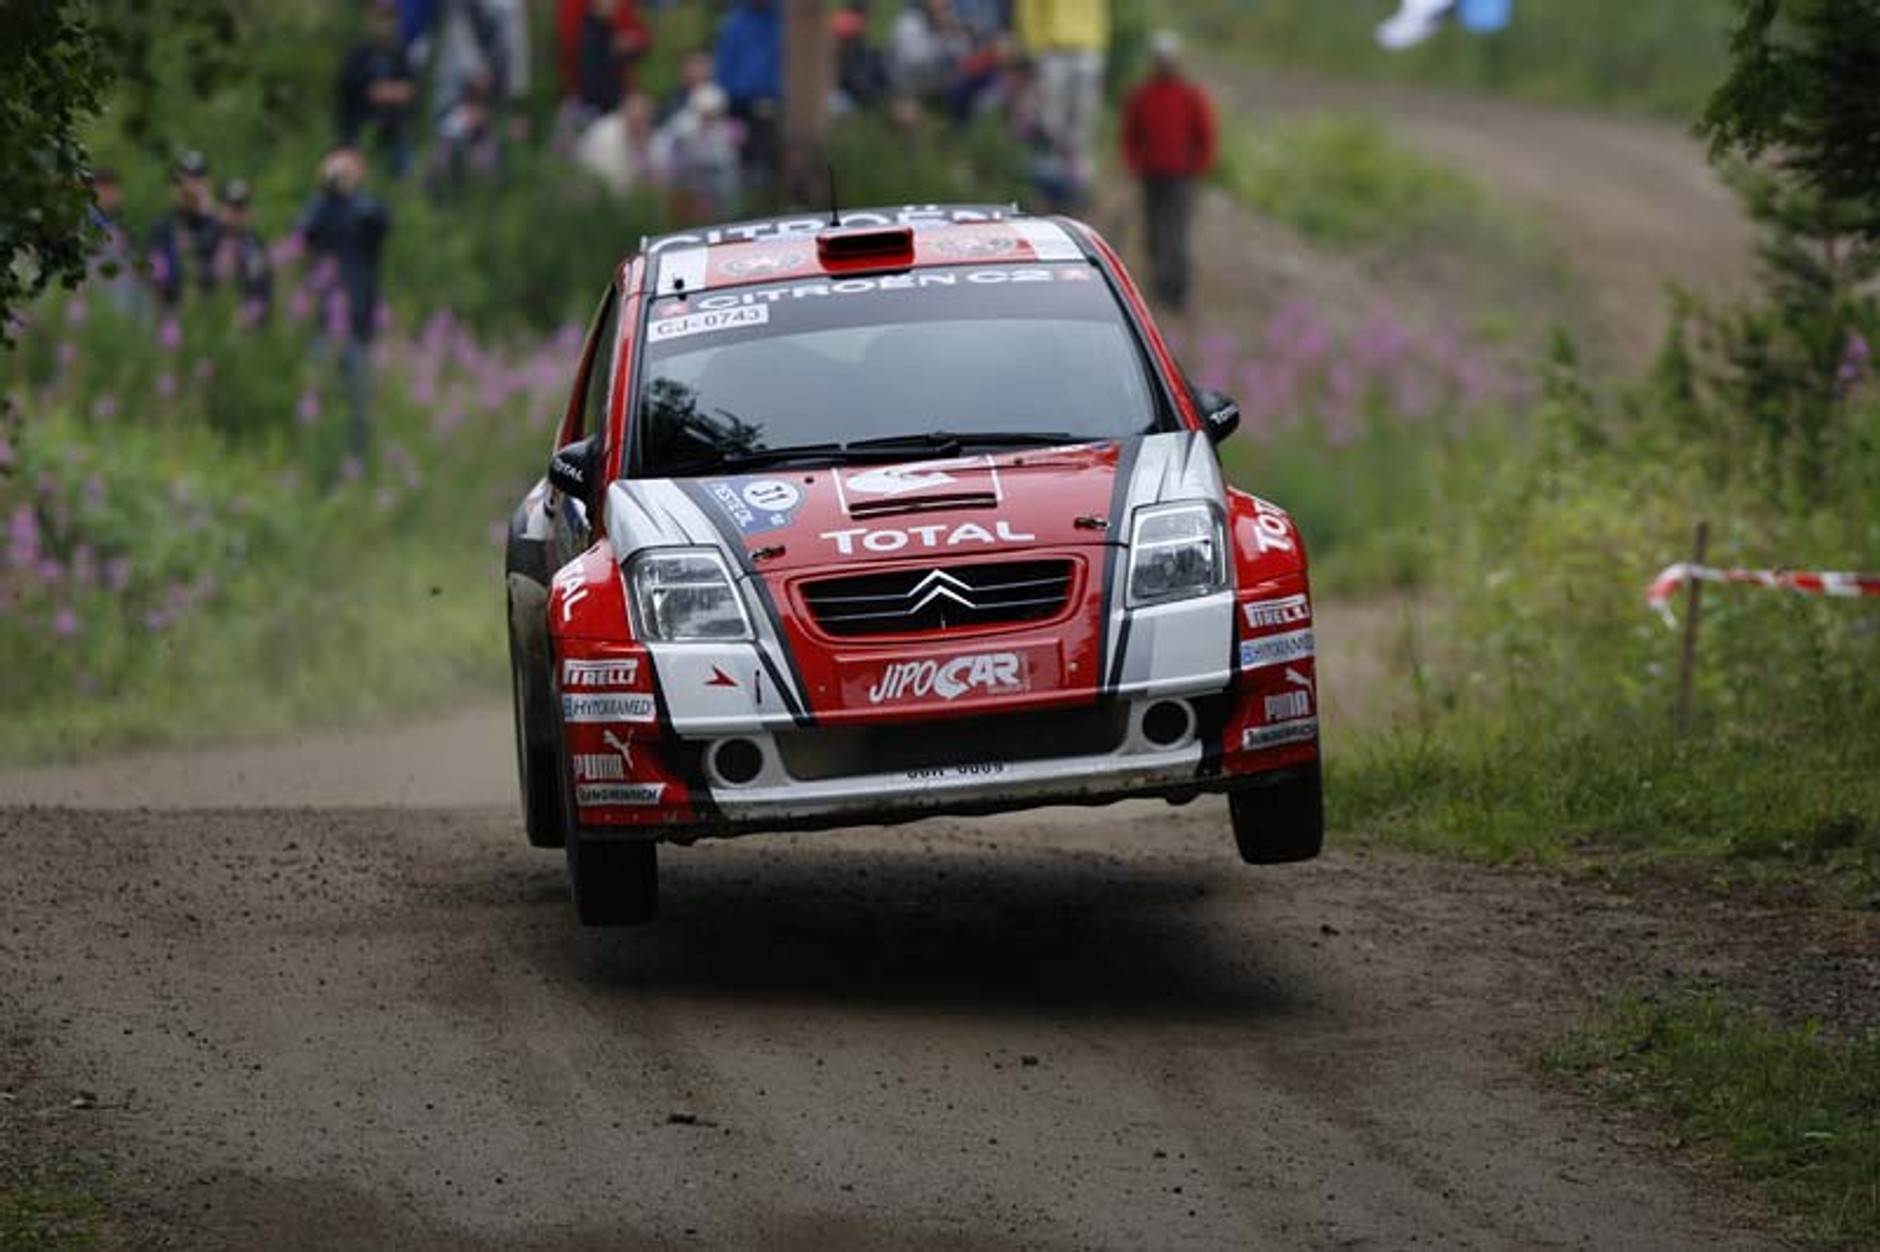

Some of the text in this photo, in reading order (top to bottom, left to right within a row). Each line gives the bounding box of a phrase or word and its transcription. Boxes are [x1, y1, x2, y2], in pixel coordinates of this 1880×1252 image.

[966, 269, 1052, 284] C2
[820, 521, 1036, 554] TOTAL
[563, 658, 638, 685] PIRELLI
[574, 754, 624, 781] PUMA
